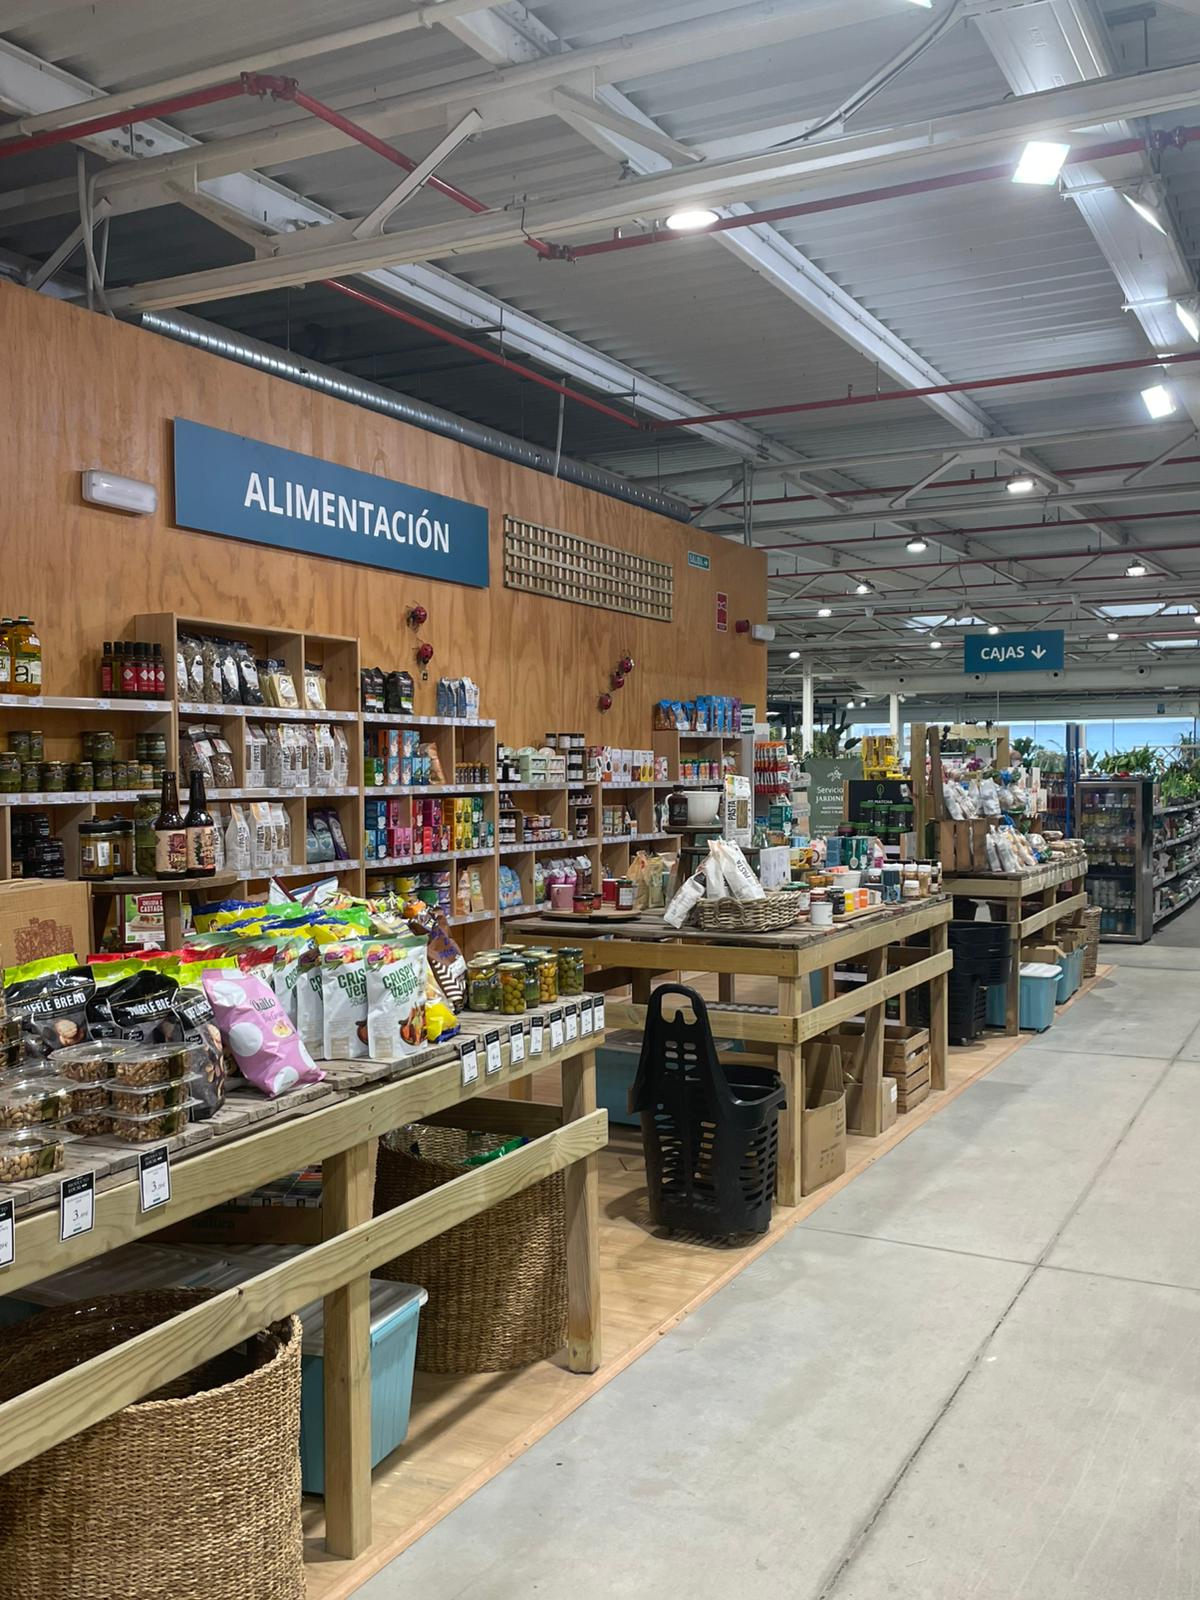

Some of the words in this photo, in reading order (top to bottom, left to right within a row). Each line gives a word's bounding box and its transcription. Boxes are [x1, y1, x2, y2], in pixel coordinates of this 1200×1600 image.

[243, 471, 450, 553] ALIMENTACIÓN
[981, 645, 1025, 662] CAJAS
[816, 786, 844, 794] Servicio
[728, 800, 737, 821] PASTA
[382, 962, 417, 989] CRISPY
[390, 977, 418, 999] veggie
[54, 992, 87, 1009] BREAD
